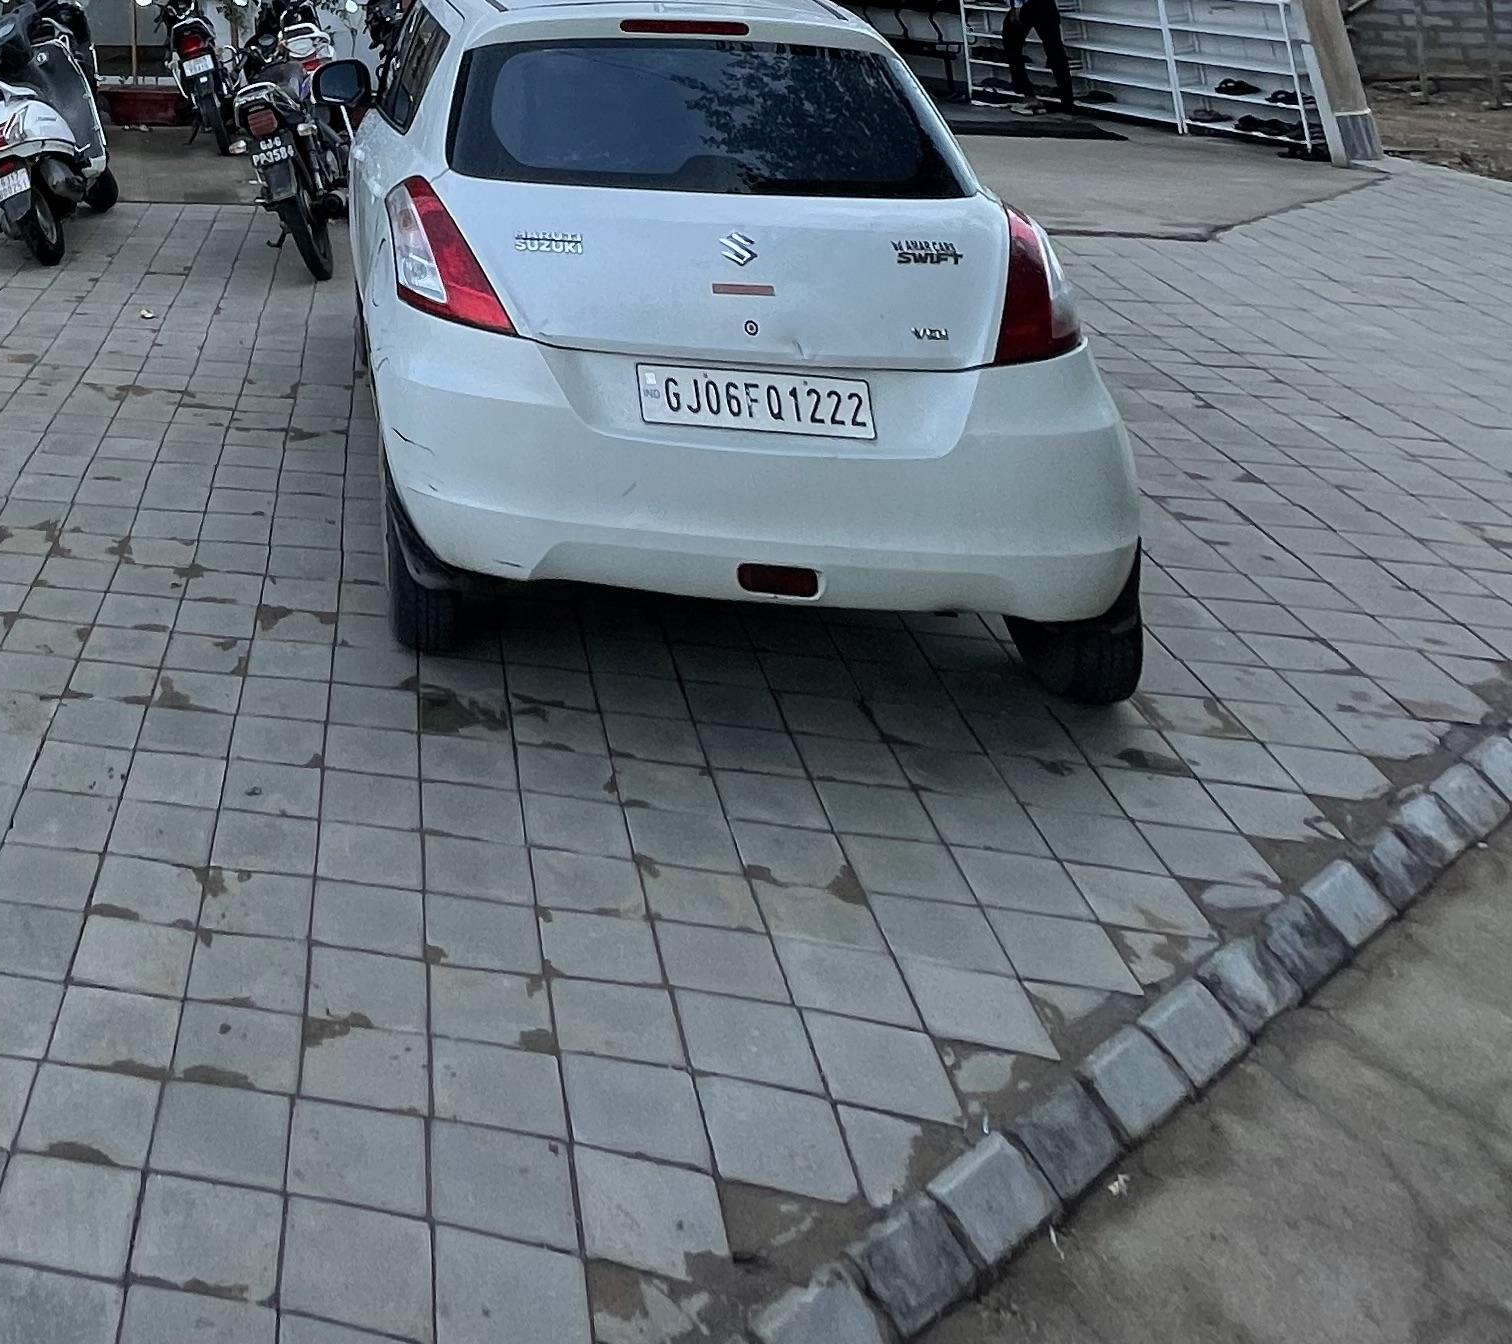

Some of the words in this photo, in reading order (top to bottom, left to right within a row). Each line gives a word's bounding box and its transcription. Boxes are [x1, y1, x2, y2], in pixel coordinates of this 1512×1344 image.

[514, 230, 583, 243] MARUTI
[514, 240, 584, 255] SUZUKI
[897, 252, 963, 265] SWIFT
[664, 377, 867, 428] GJ06FQ1222
